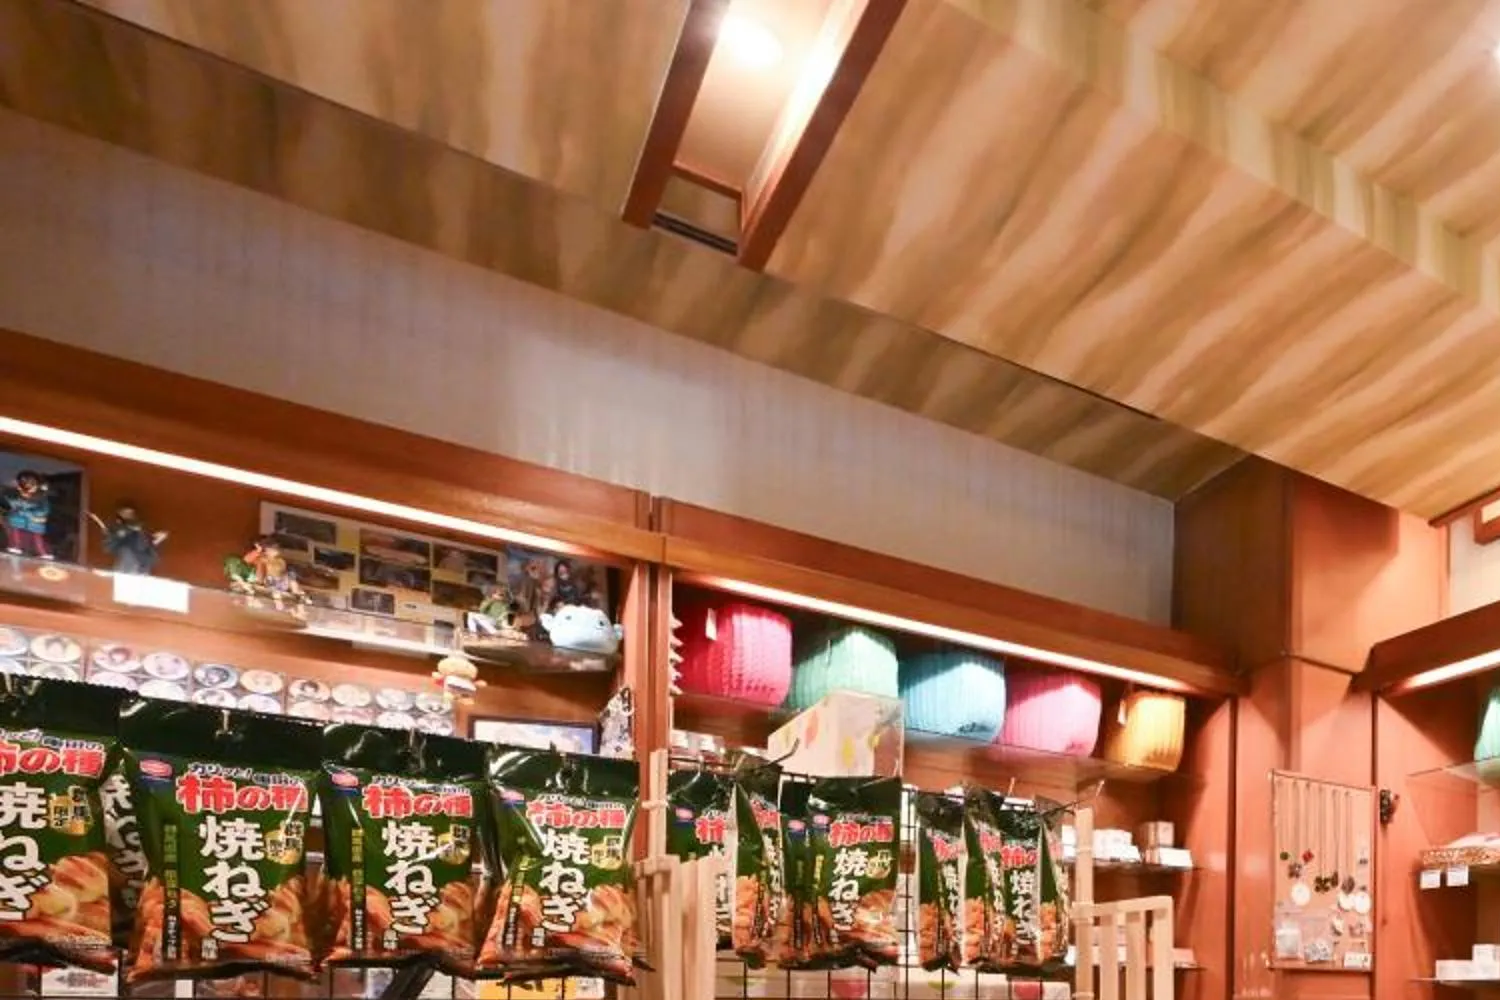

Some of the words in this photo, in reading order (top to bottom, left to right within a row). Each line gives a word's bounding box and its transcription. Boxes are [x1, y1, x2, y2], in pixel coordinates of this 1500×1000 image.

[176, 773, 308, 814] 柿の種
[362, 784, 473, 818] 柿の種
[199, 815, 271, 943] 焼ねぎ
[381, 820, 440, 934] 焼ねぎ
[538, 828, 593, 932] 焼ねぎ
